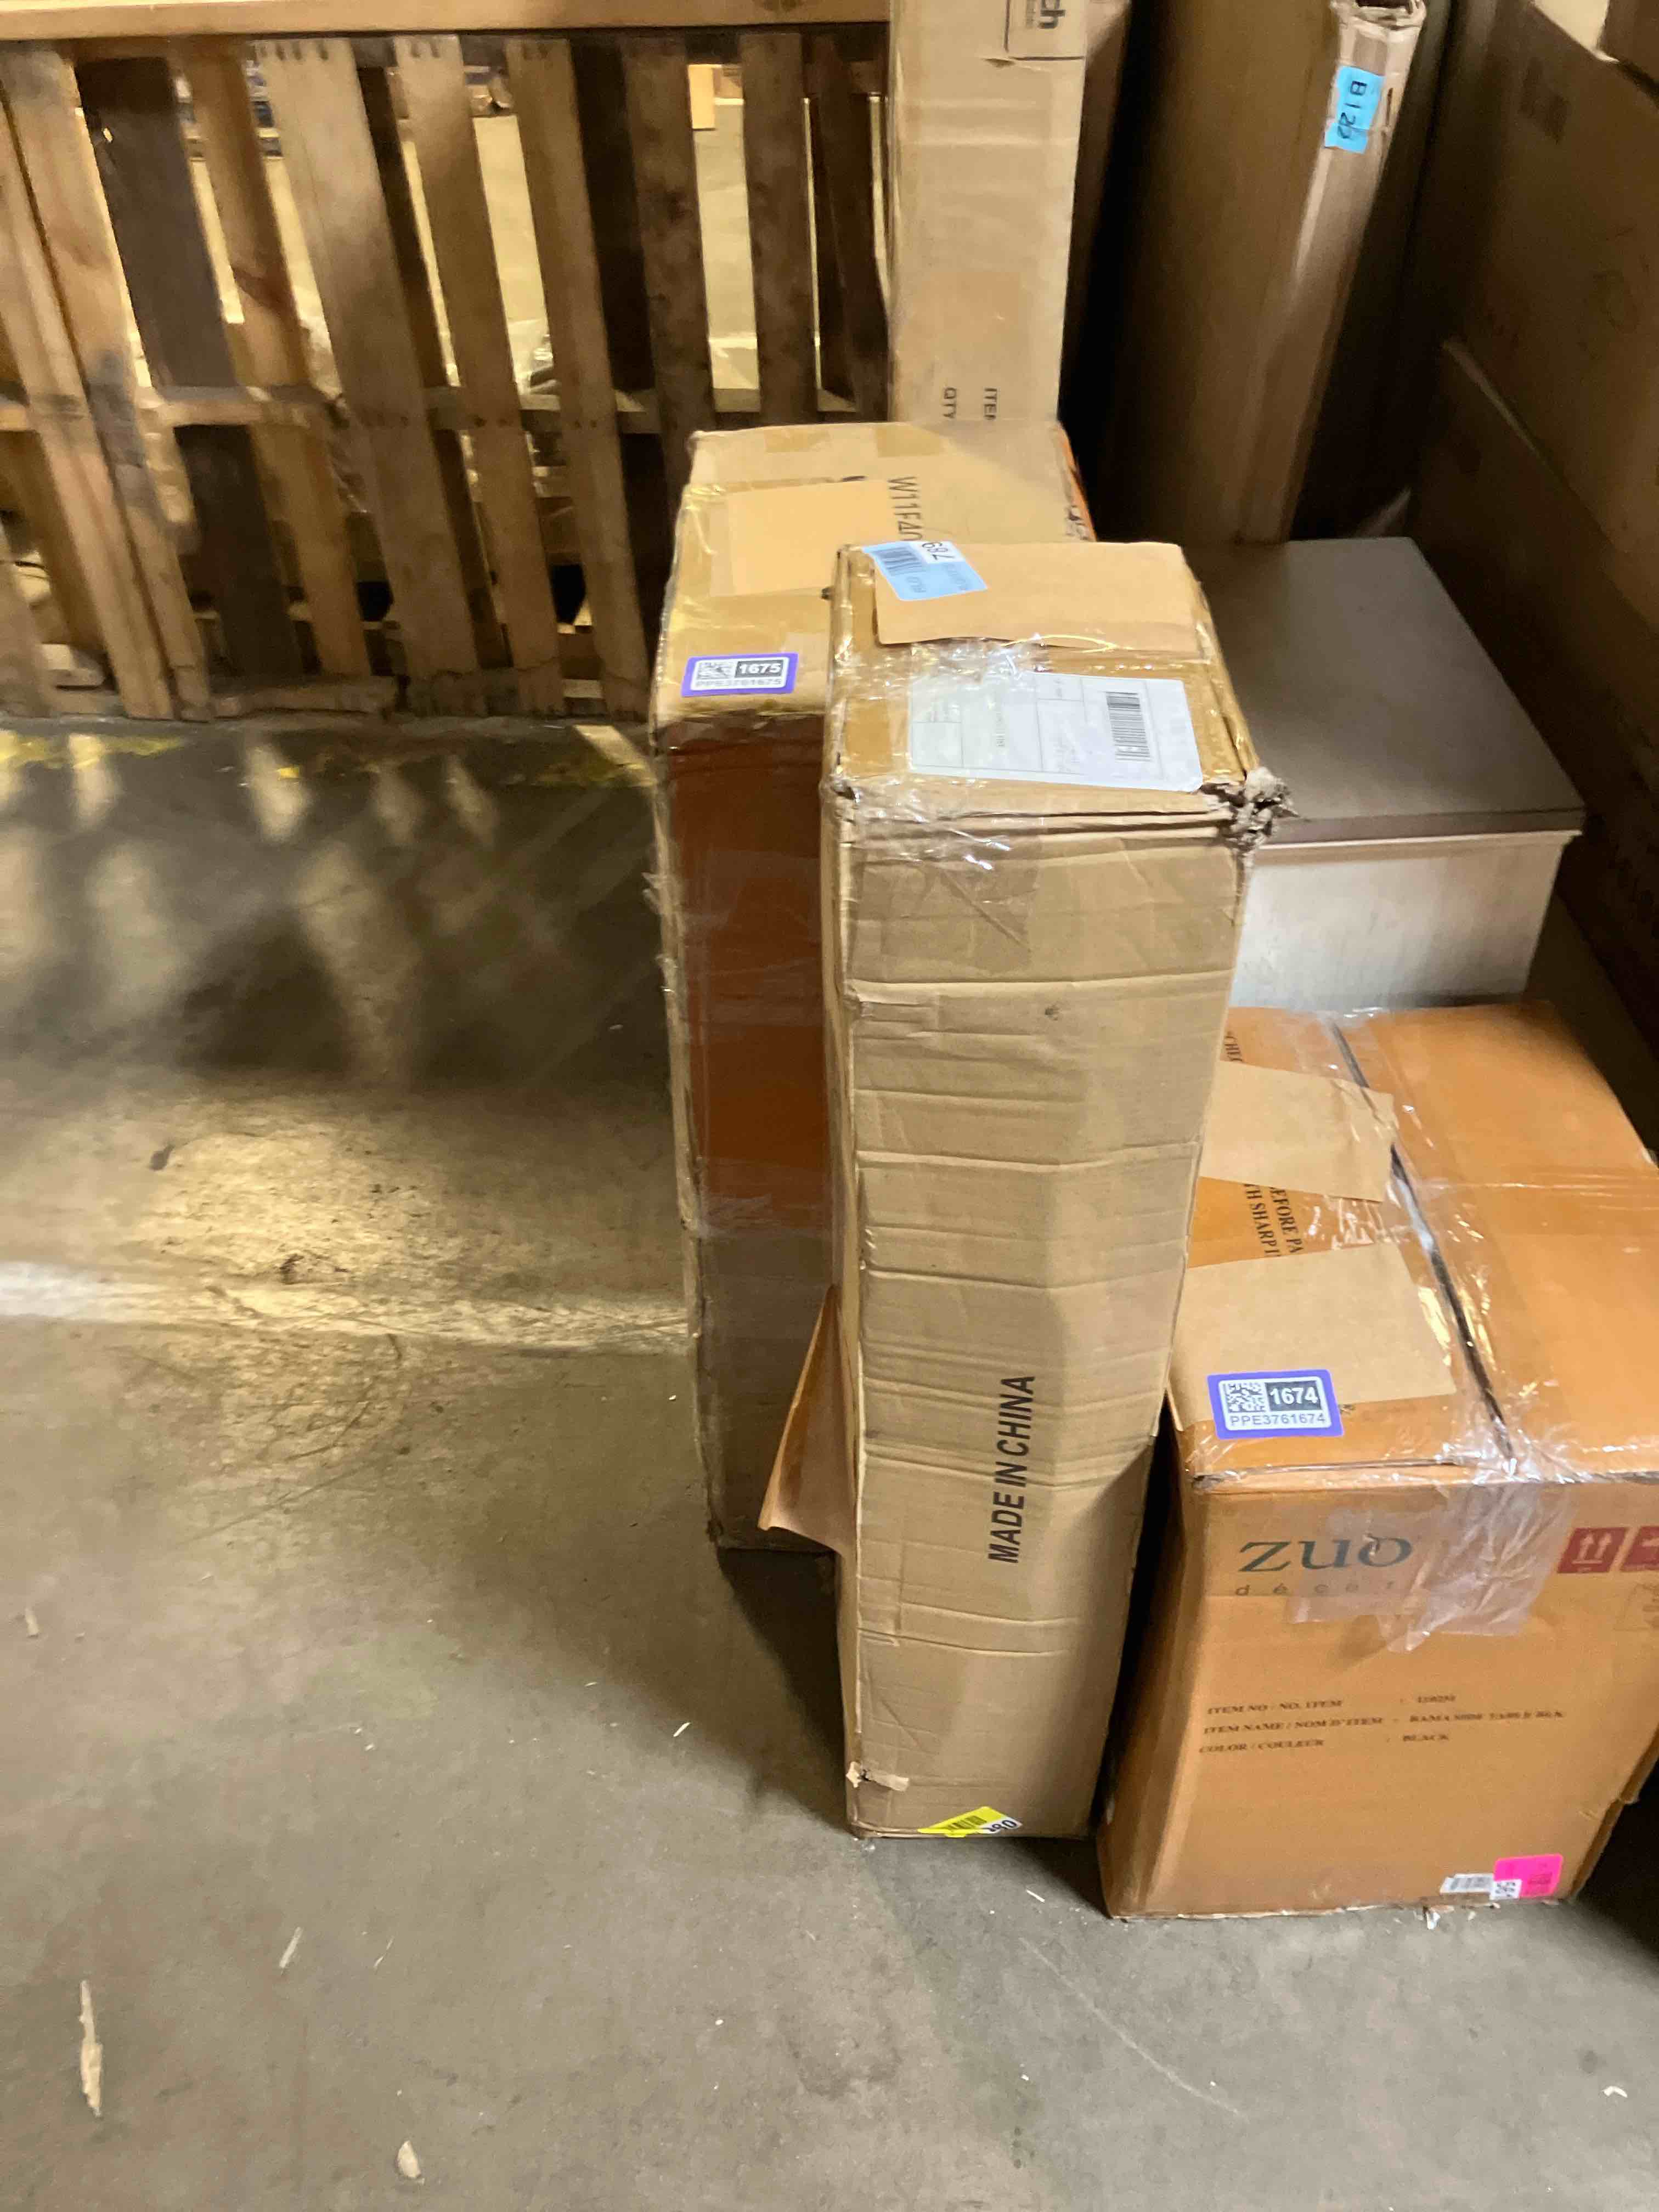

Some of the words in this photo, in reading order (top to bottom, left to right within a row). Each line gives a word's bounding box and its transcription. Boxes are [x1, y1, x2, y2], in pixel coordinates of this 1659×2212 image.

[943, 387, 956, 418] QTY
[739, 663, 781, 674] 1675
[1269, 1187, 1299, 1235] EFORE
[1250, 1203, 1277, 1246] SHARP
[1269, 1386, 1318, 1405] 1674
[996, 1376, 1035, 1457] CHINA
[1229, 1413, 1326, 1426] PPE3761674
[994, 1461, 1028, 1488] IN
[988, 1491, 1025, 1564] MADE
[1207, 1705, 1244, 1714] ITEM
[1204, 1725, 1240, 1734] ITEM
[1199, 1743, 1247, 1754] COLOR
